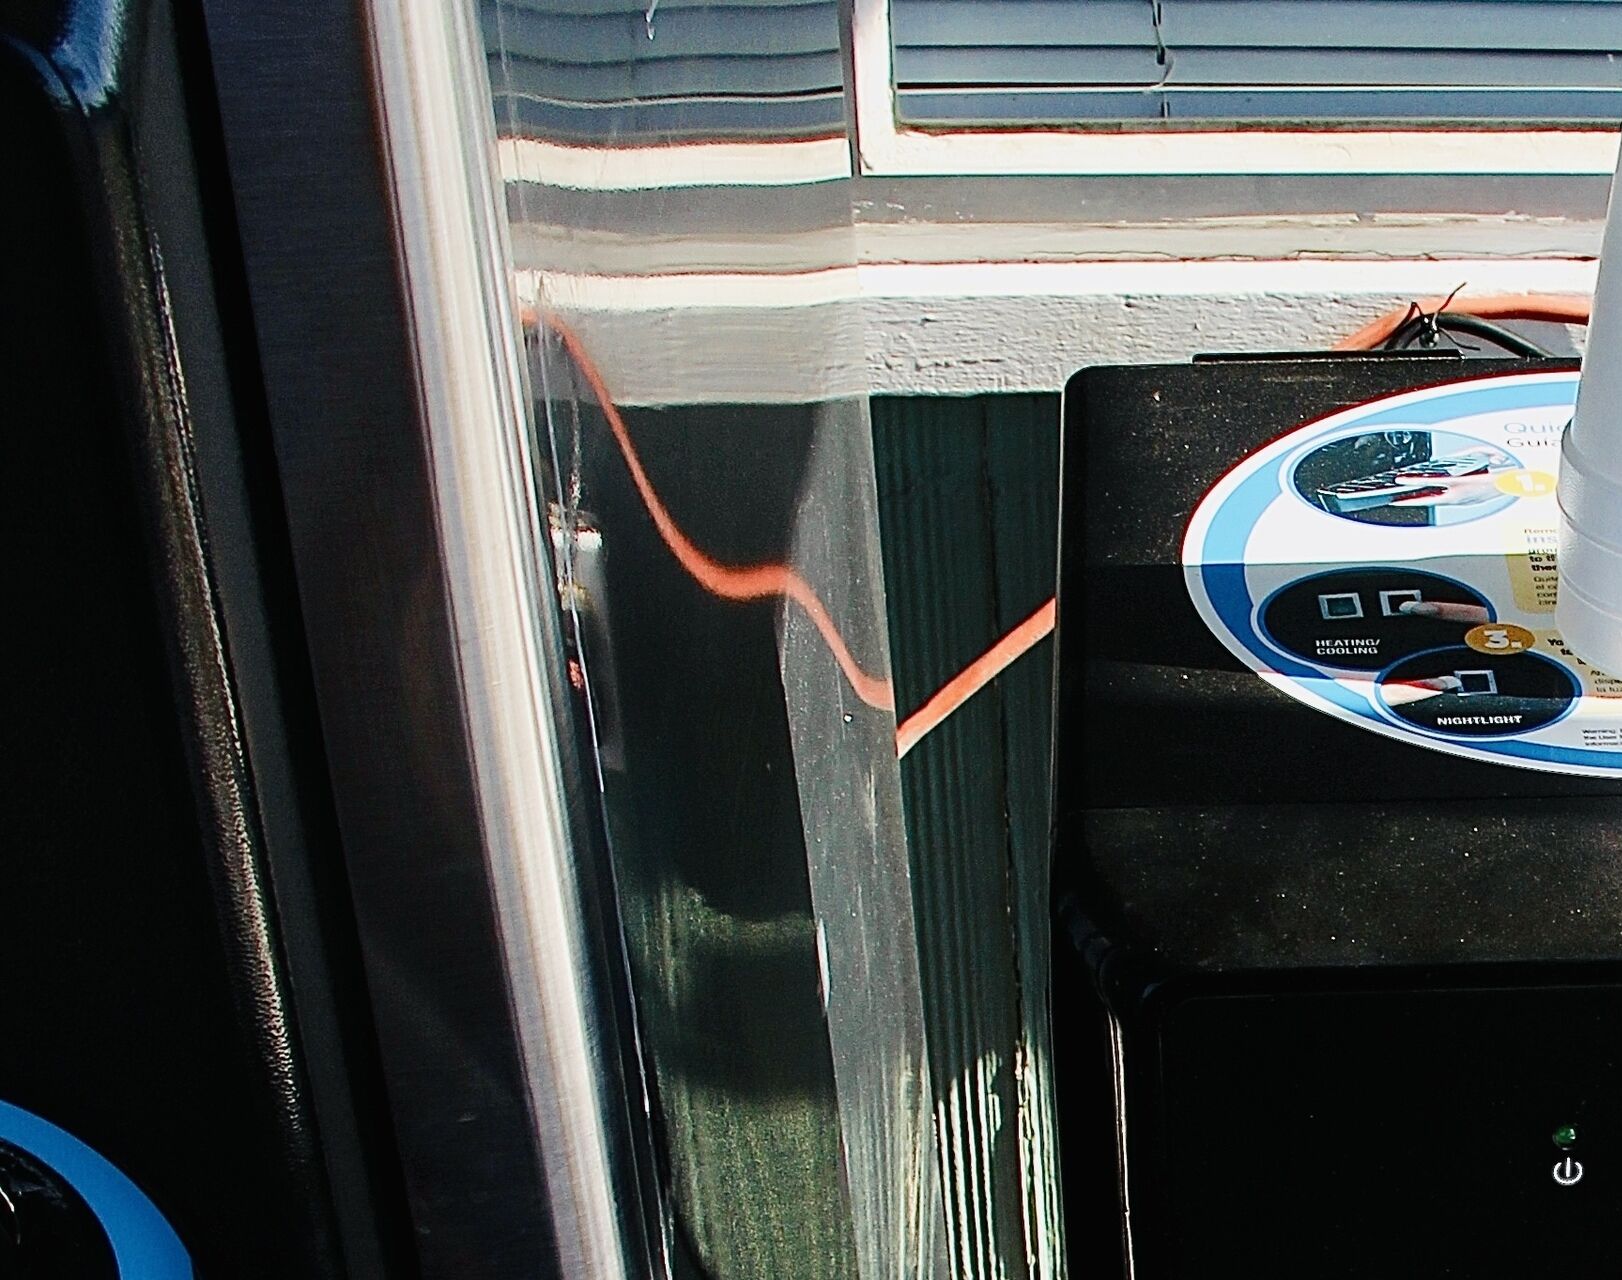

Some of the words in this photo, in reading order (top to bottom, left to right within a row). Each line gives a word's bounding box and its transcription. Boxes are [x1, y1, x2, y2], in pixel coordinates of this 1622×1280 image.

[1315, 638, 1381, 648] HEATING/
[1484, 629, 1524, 649] 3.
[1316, 646, 1379, 656] COOLING
[1436, 714, 1523, 727] NIGHTLIGHT
